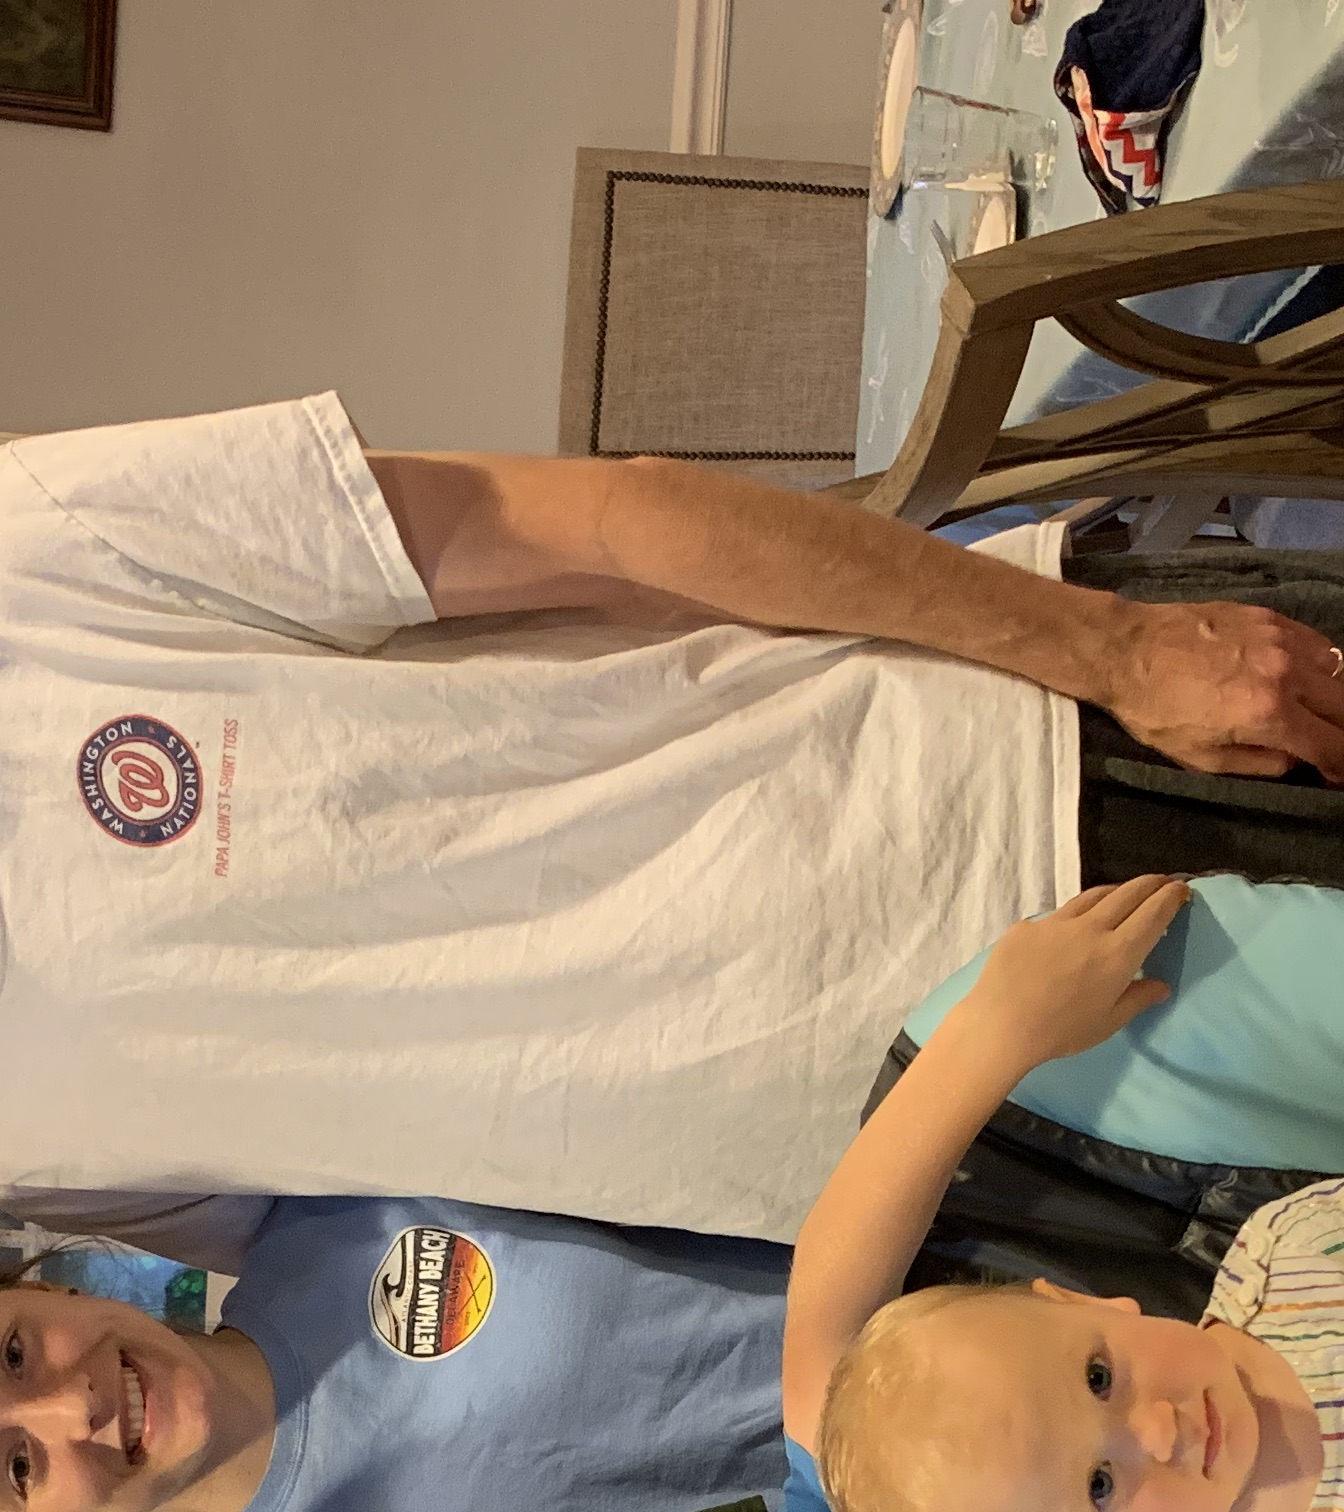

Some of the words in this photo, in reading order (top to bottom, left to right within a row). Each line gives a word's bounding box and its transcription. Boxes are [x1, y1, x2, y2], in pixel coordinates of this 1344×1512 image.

[222, 718, 238, 751] TOSS
[83, 721, 133, 834] WASHINGTON
[111, 750, 170, 813] W
[160, 735, 197, 837] NATIONALS
[218, 753, 236, 800] T-SHIRT
[216, 802, 231, 845] JOHN'S
[214, 847, 229, 878] PAPA
[418, 1229, 451, 1281] BEACH
[401, 1287, 413, 1323] ATLANTIC
[412, 1283, 440, 1355] BETHANY
[446, 1260, 465, 1326] DELAWARE
